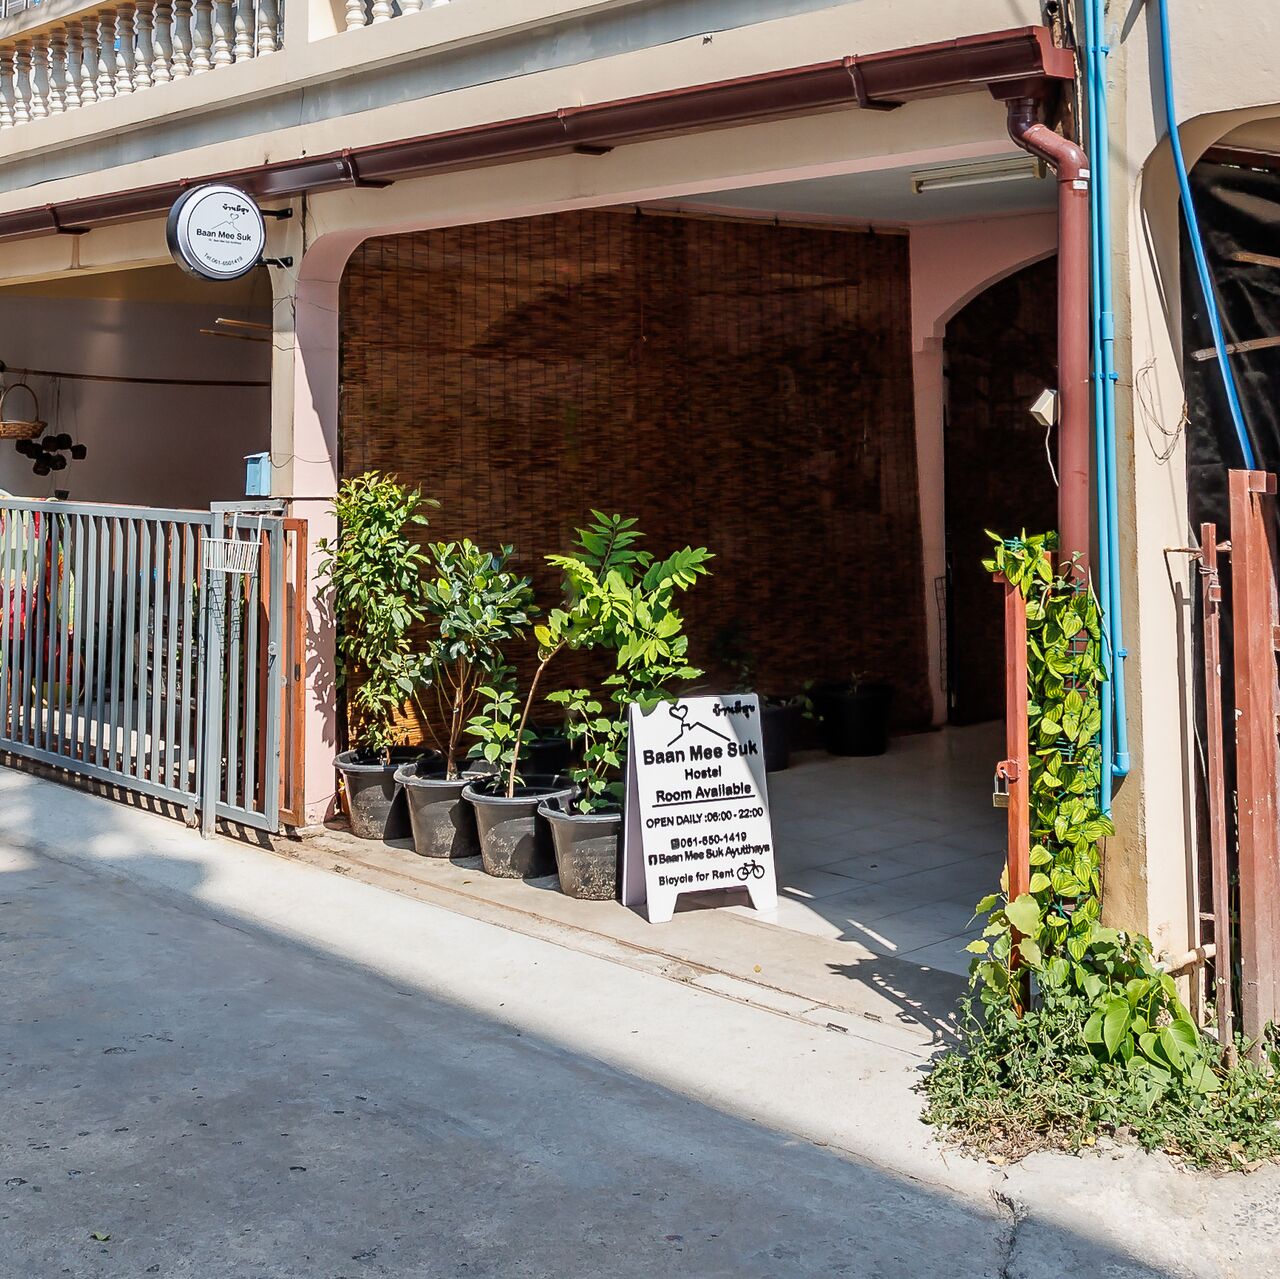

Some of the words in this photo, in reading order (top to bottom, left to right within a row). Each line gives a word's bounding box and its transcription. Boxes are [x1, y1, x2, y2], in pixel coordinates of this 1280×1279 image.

[196, 228, 216, 238] Baan
[218, 231, 235, 240] Mee
[236, 232, 252, 242] Suk
[643, 749, 686, 766] Baan
[689, 744, 723, 762] Mee
[727, 739, 759, 758] Suk
[684, 765, 722, 781] Hostel
[655, 790, 692, 803] Room
[695, 781, 752, 799] Available
[646, 816, 674, 829] OPEN
[676, 812, 703, 826] DAILY
[738, 806, 764, 820] 22:00
[680, 831, 747, 848] 061-650-1419
[658, 854, 684, 865] Baan
[684, 850, 705, 862] Mee
[705, 847, 724, 859] Suk
[725, 843, 770, 859] Ayutthaya
[658, 873, 694, 887] Bicycle
[695, 871, 710, 882] for
[711, 867, 735, 880] Rent
